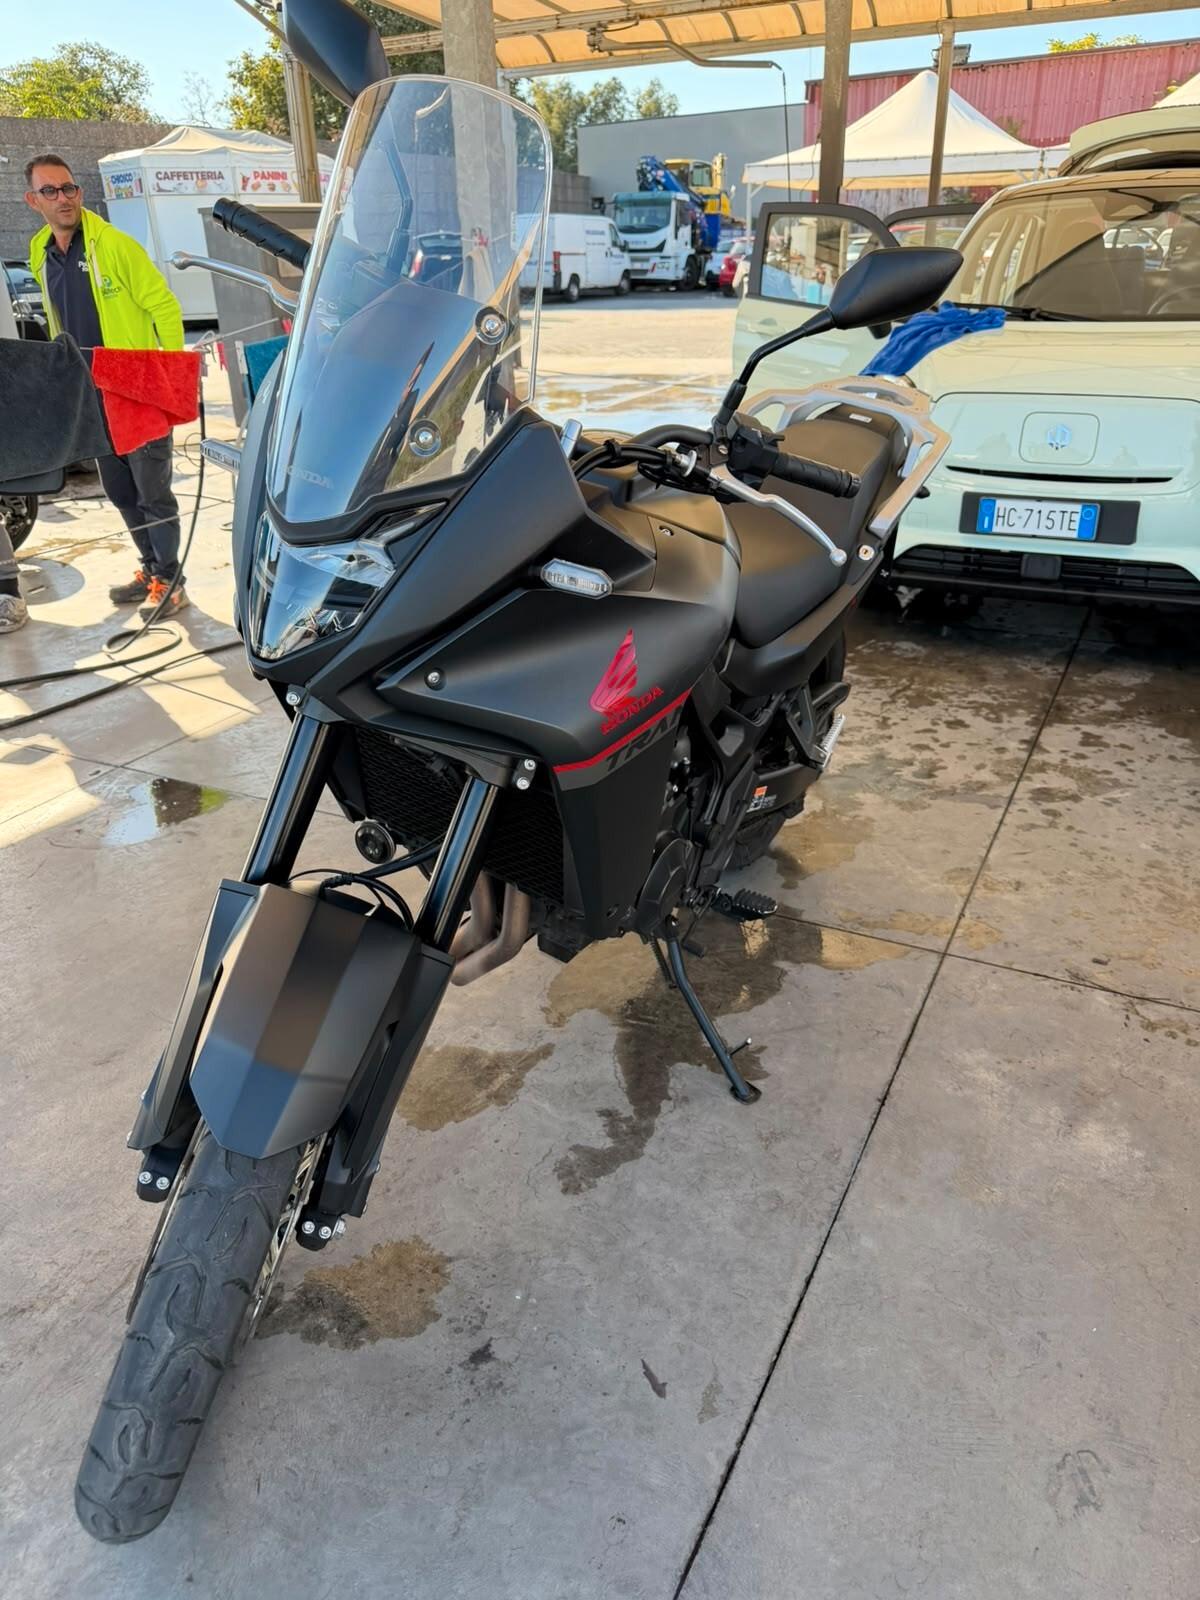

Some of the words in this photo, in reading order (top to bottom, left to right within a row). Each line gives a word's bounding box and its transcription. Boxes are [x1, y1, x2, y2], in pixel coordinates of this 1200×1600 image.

[155, 170, 225, 181] CAFFETTERIA
[253, 170, 288, 181] PANINI
[601, 687, 664, 736] HONDA
